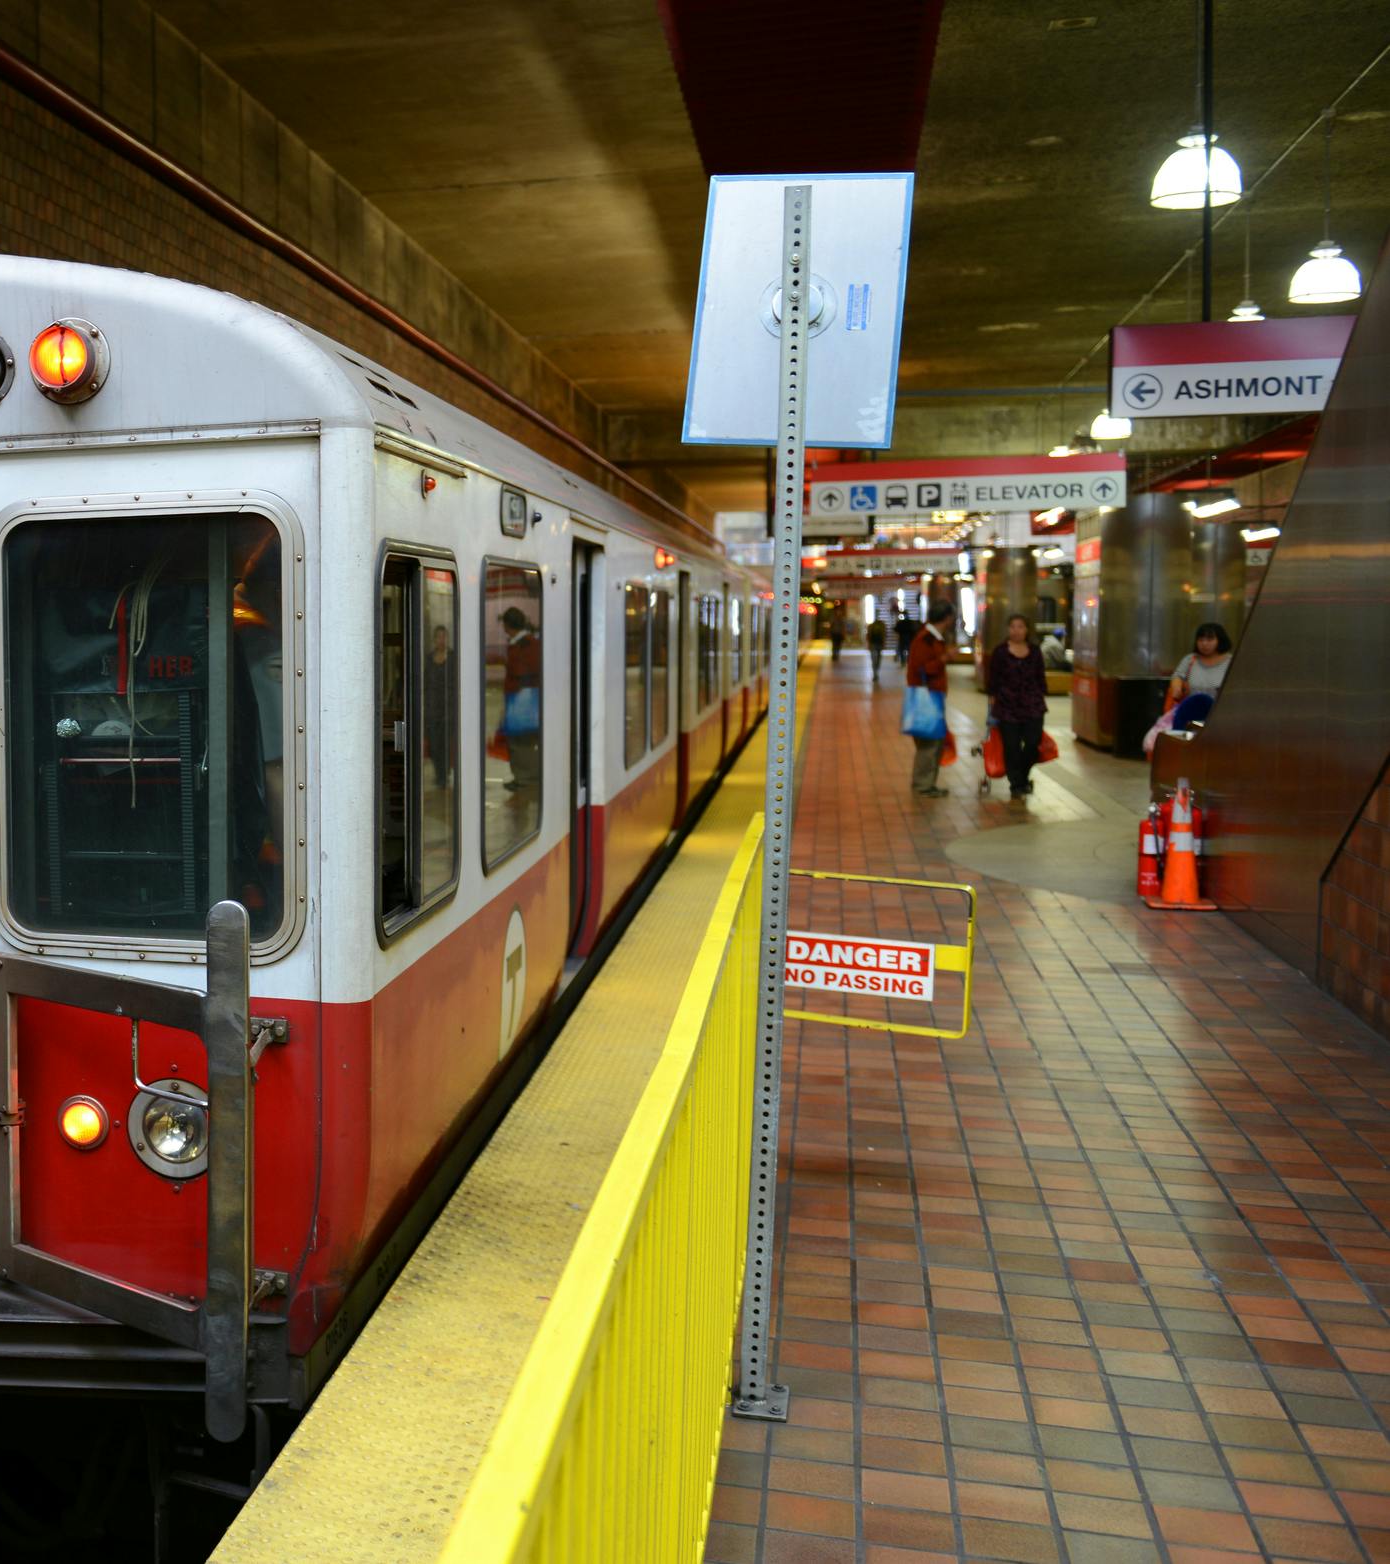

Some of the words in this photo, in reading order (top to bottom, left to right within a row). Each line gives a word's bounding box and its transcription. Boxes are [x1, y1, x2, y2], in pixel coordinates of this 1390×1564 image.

[1174, 375, 1323, 400] ASHMONT
[976, 483, 1084, 502] ELEVATOR
[787, 940, 922, 972] DANGER
[785, 968, 816, 985] NO
[824, 973, 924, 995] PASSING
